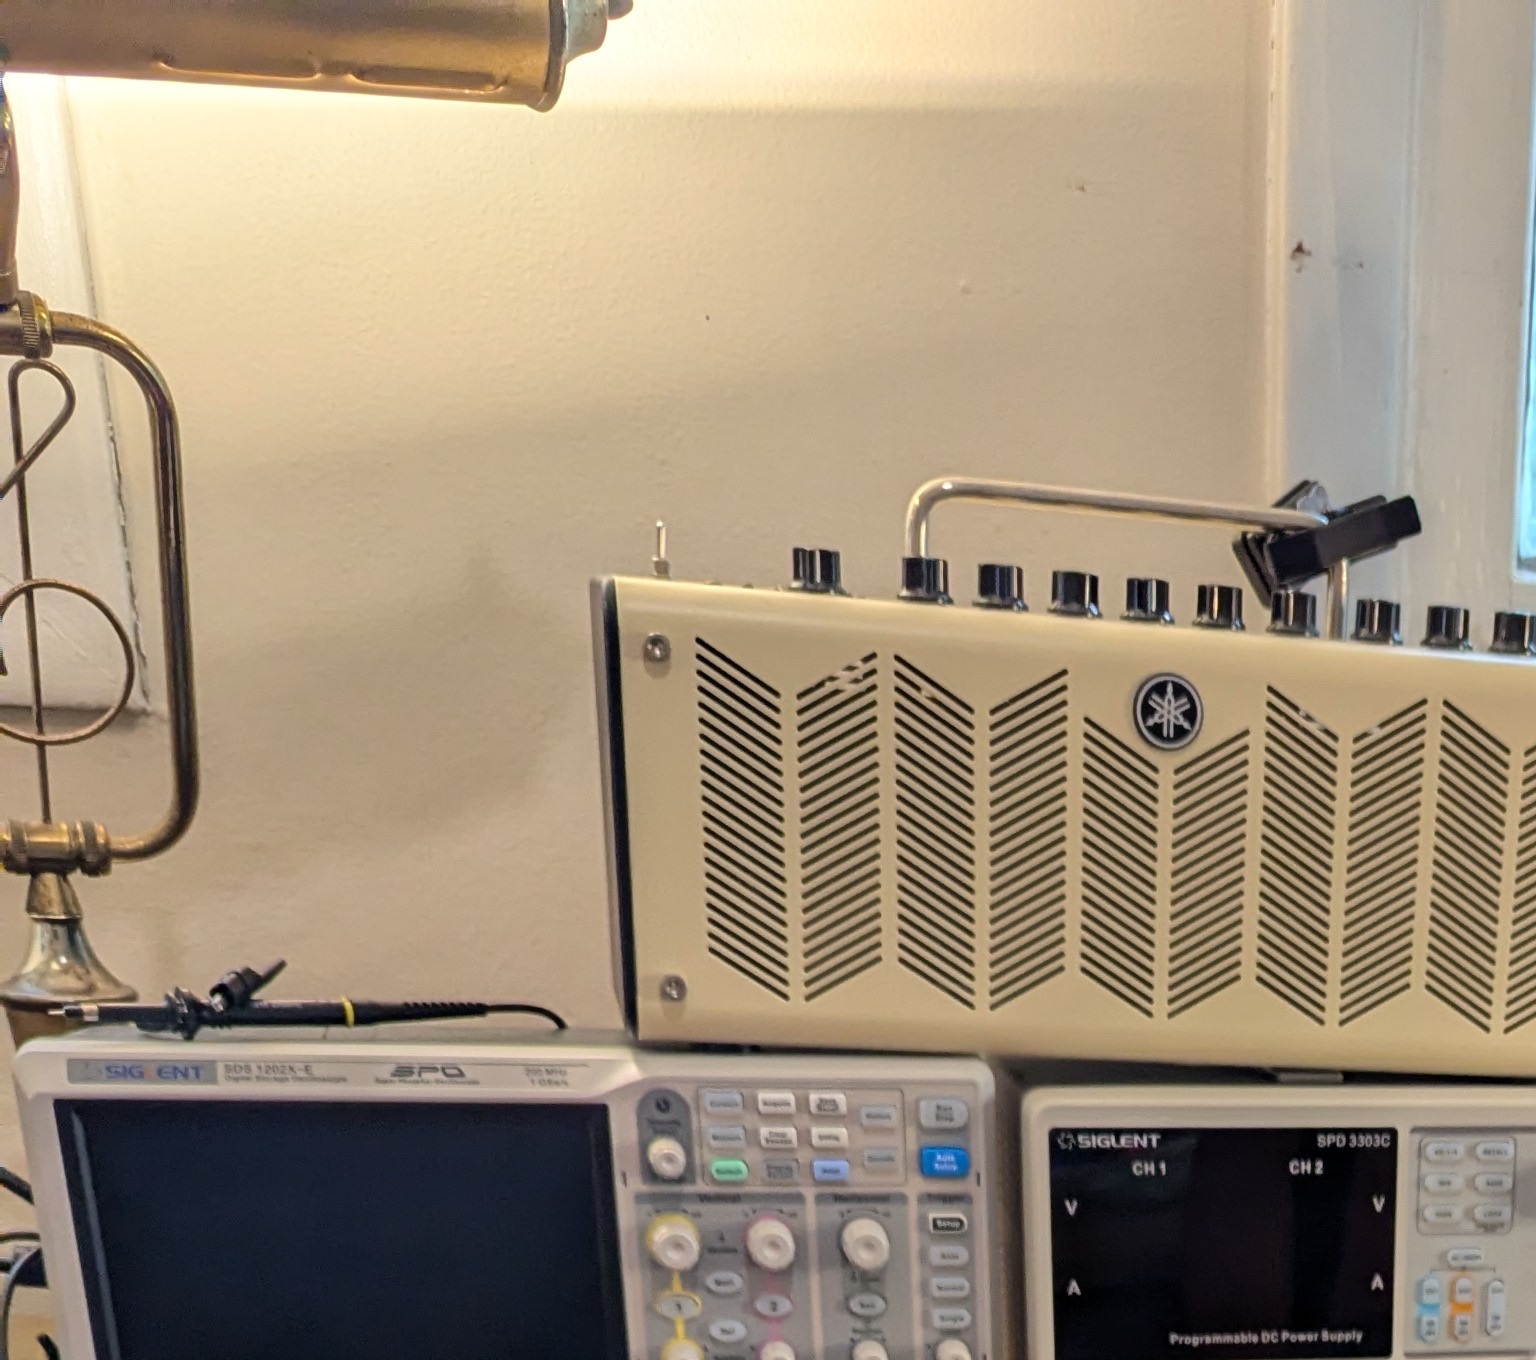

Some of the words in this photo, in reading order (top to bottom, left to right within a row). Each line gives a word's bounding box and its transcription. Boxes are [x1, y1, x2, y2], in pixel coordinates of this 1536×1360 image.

[1078, 1133, 1161, 1149] SIGLENT
[1316, 1133, 1346, 1148] SPD
[1349, 1133, 1392, 1148] 3303C
[1132, 1161, 1156, 1176] CH
[1158, 1161, 1167, 1176] 1
[1288, 1159, 1312, 1175] CH
[1313, 1159, 1324, 1175] 2
[1064, 1199, 1079, 1217] V
[1372, 1195, 1386, 1213] V
[1066, 1278, 1082, 1296] A
[1370, 1272, 1384, 1291] A
[1168, 1330, 1259, 1347] Programmable
[1260, 1330, 1280, 1344] DC
[1280, 1330, 1320, 1344] Power
[1320, 1328, 1364, 1344] Supply
